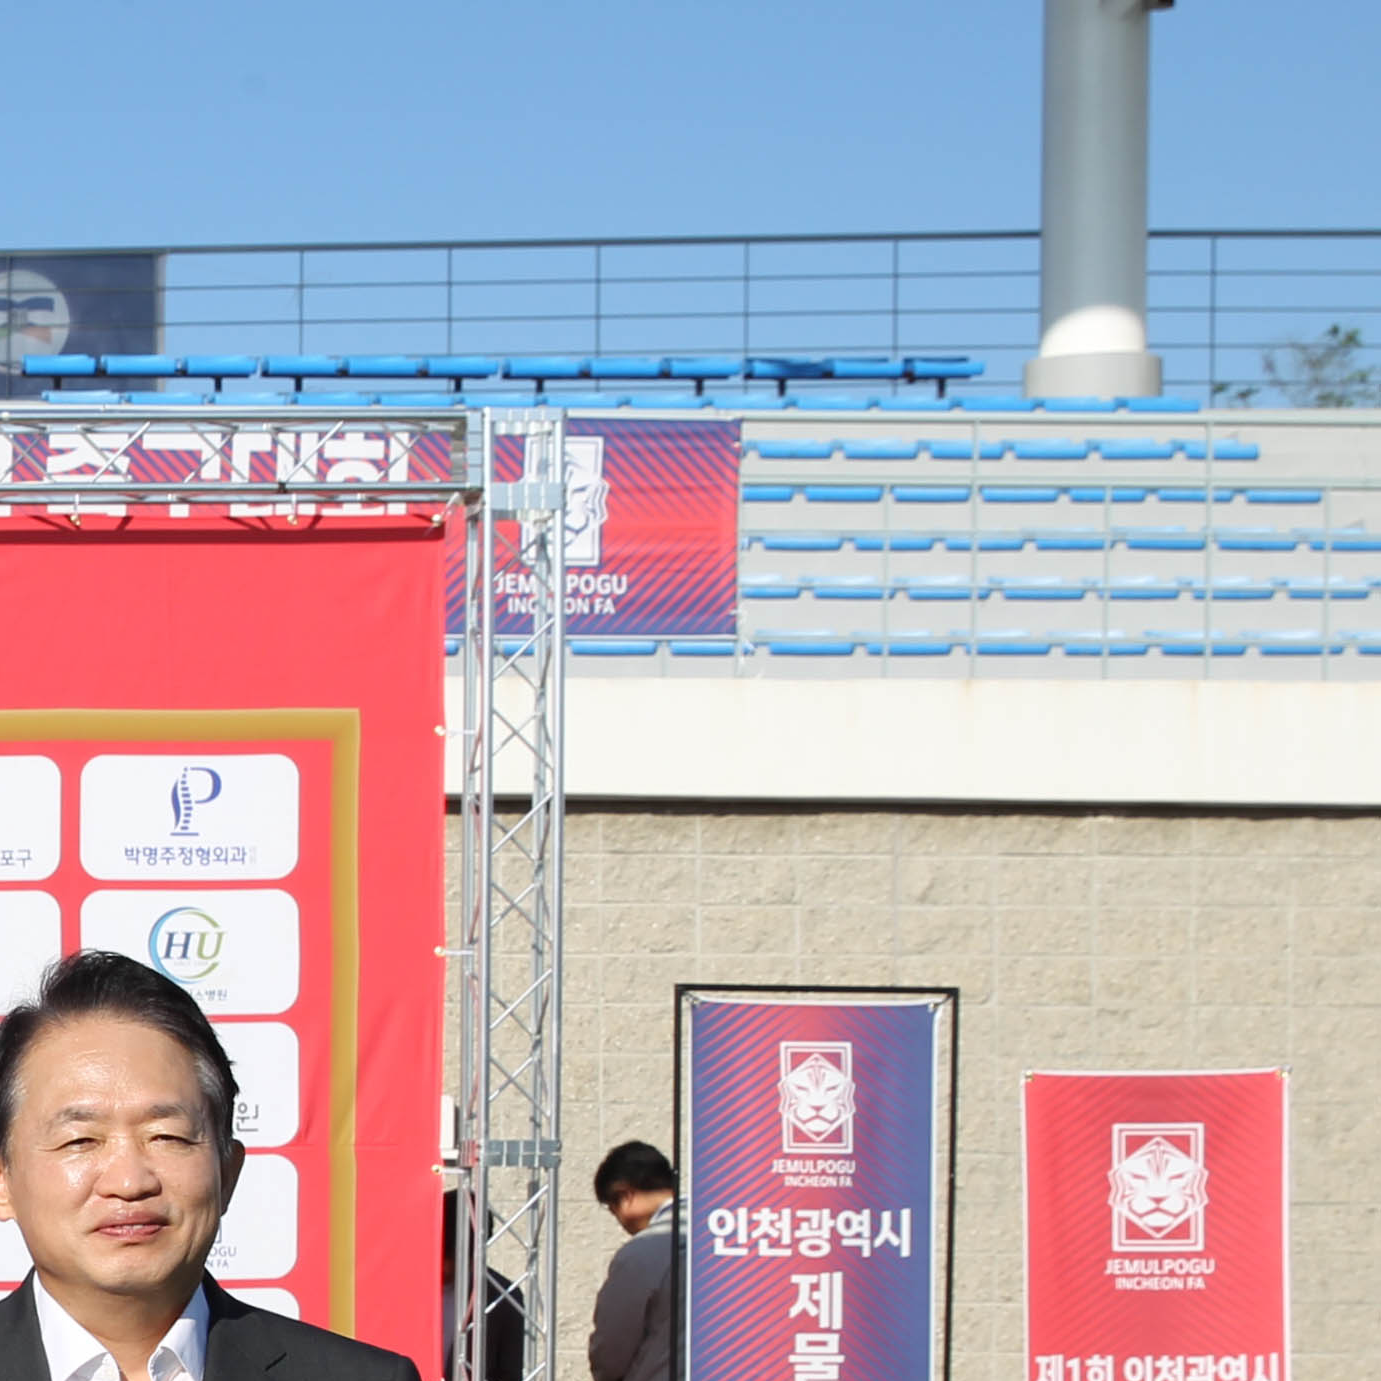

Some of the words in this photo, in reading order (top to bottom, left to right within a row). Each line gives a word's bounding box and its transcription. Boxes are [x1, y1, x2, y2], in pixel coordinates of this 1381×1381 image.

[594, 597, 616, 614] FA
[124, 846, 247, 866] 박명주정형외과
[771, 1159, 856, 1173] JEMULPOGU
[784, 1176, 837, 1187] INCHEON
[840, 1176, 853, 1187] FA
[707, 1207, 911, 1258] 인천광역시
[1104, 1259, 1215, 1275] JEMULPOGU
[1115, 1277, 1184, 1290] INCHEON
[1187, 1277, 1206, 1290] FA
